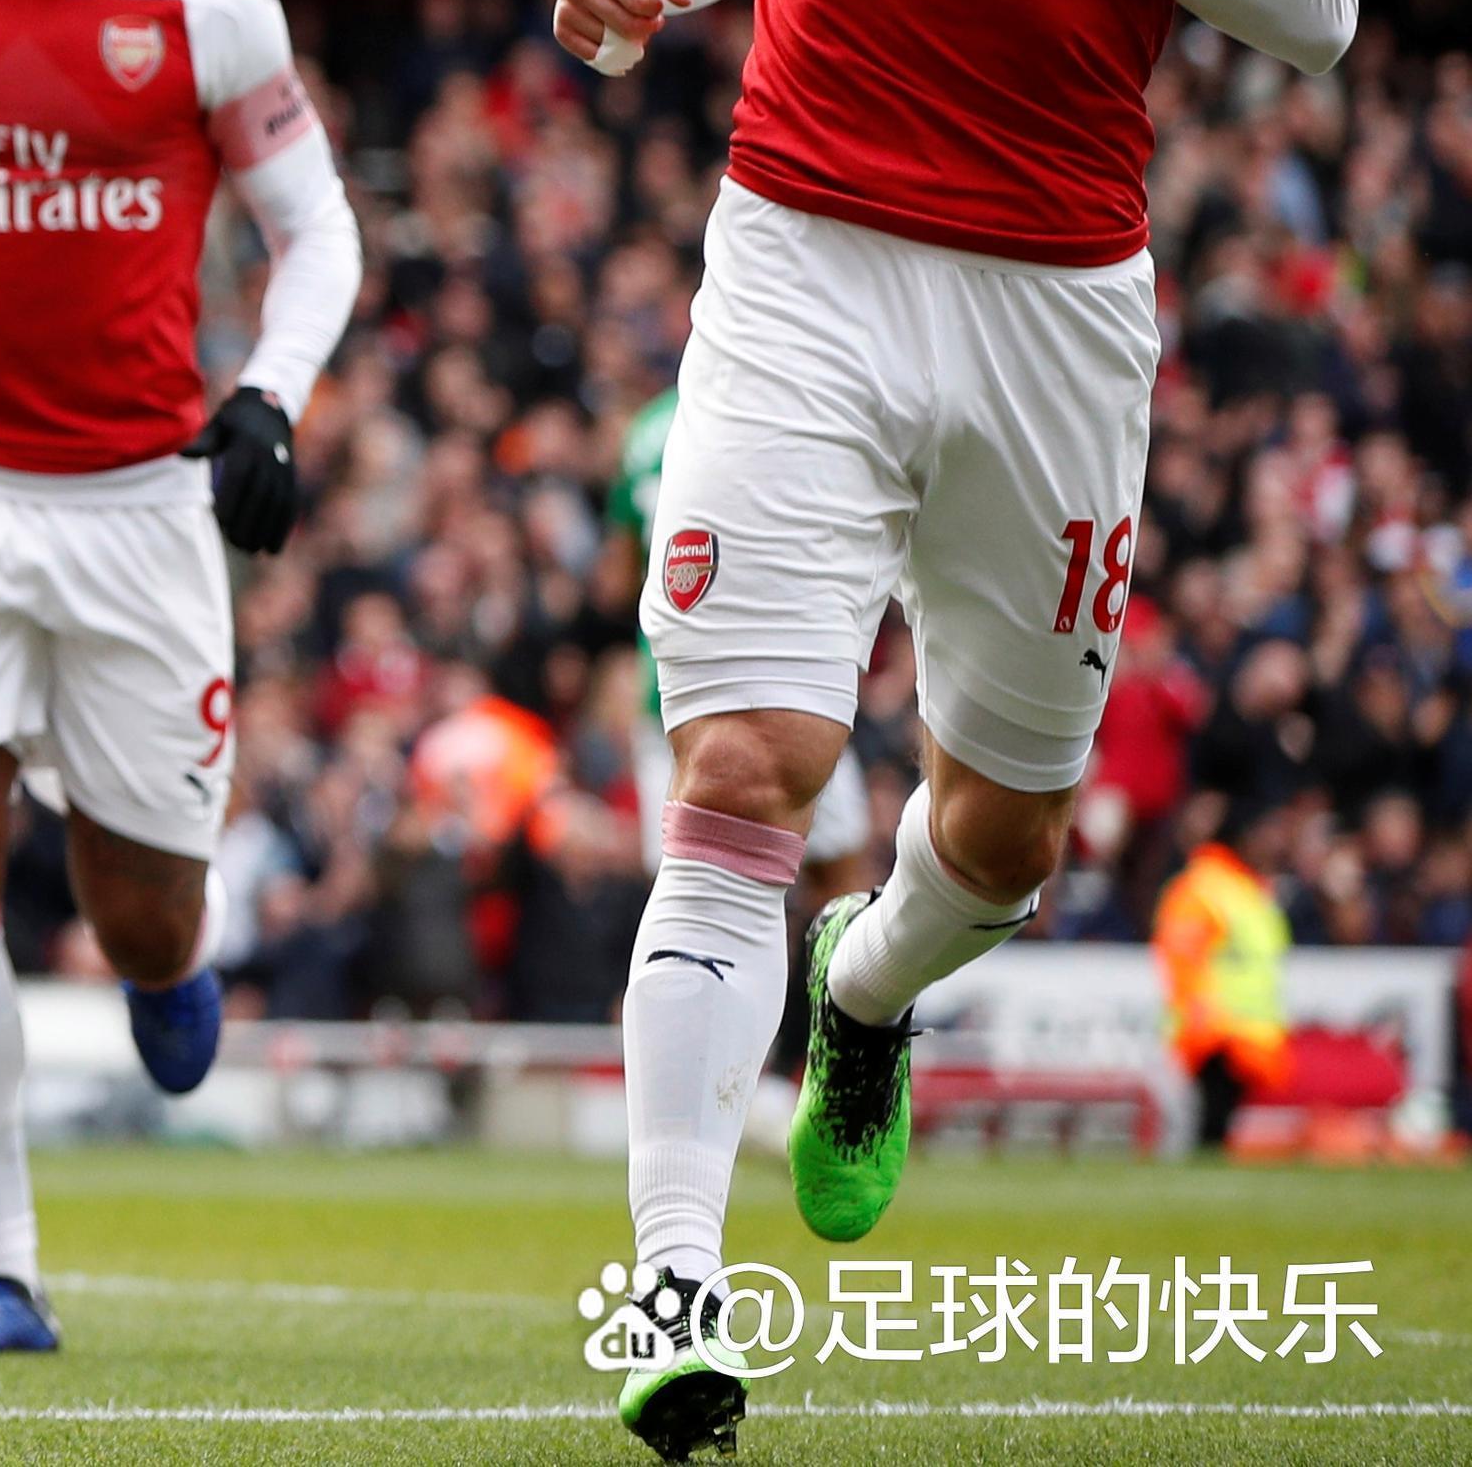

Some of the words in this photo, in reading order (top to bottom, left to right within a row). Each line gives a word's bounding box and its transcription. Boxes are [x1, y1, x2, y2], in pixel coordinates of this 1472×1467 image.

[669, 541, 710, 559] Arsenal
[1051, 514, 1133, 635] 18
[198, 676, 235, 768] 9
